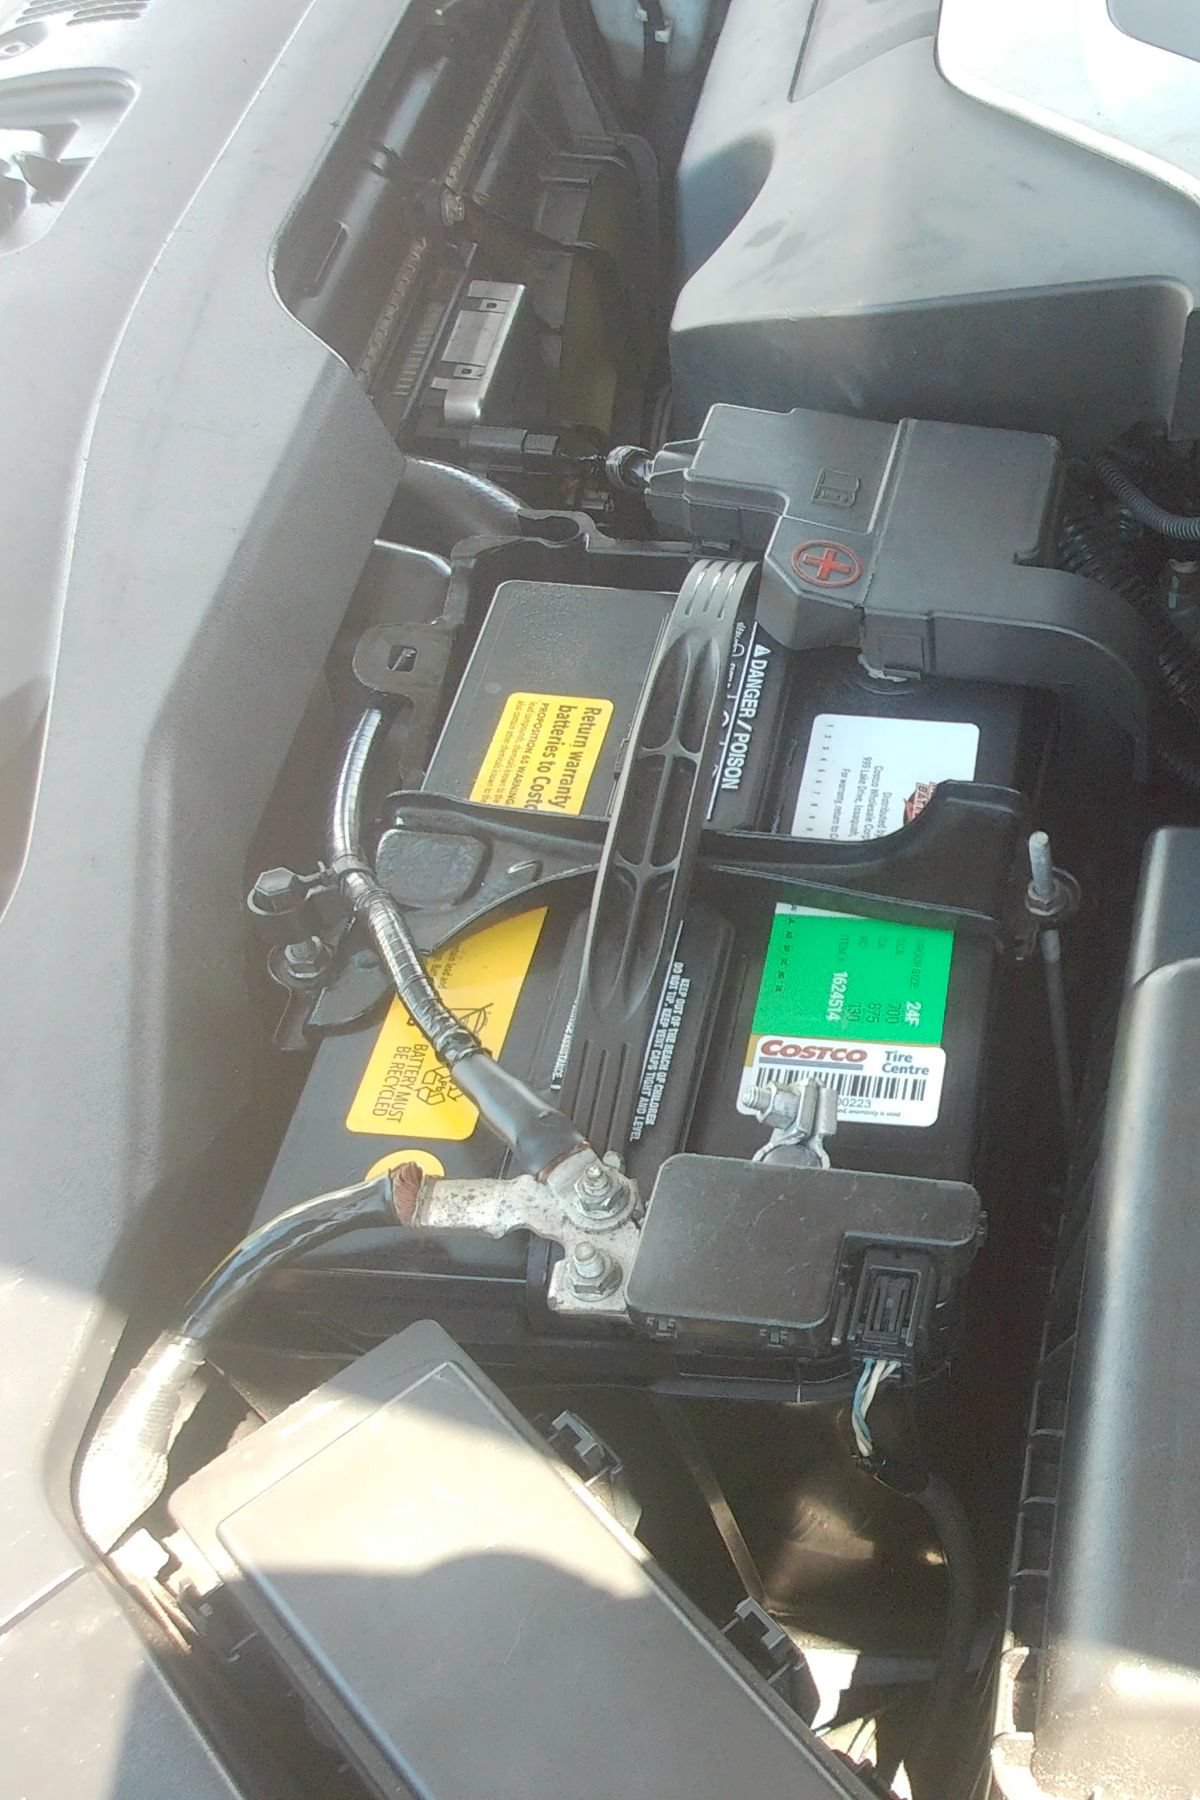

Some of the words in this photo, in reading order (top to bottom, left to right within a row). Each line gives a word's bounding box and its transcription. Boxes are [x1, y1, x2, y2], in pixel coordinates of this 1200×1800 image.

[526, 703, 549, 755] PROPOSITION
[545, 705, 577, 758] batteries
[573, 707, 602, 748] Return
[521, 755, 530, 764] 65
[537, 757, 557, 773] to
[861, 756, 873, 768] 999
[548, 751, 583, 808] warranty
[859, 769, 870, 784] Lake
[524, 776, 551, 810] Costc
[674, 962, 684, 972] DO
[669, 974, 680, 991] NOT
[679, 978, 690, 997] KEEP
[674, 998, 685, 1014] OUT
[826, 971, 848, 1022] 1624514
[659, 1008, 672, 1029] KEEP
[670, 1015, 681, 1027] OF
[847, 1002, 862, 1023] 130
[866, 1002, 881, 1023] 875
[887, 1002, 901, 1024] 700
[904, 1001, 922, 1028] 24F
[654, 1029, 667, 1049] VENT
[393, 1046, 411, 1059] BE
[648, 1050, 661, 1070] CAPS
[658, 1044, 674, 1071] REACH
[885, 1051, 912, 1063] Tire
[404, 1043, 428, 1090] BATTERY
[882, 1063, 929, 1075] Centre
[642, 1071, 654, 1097] TIGHT
[656, 1072, 667, 1083] OF
[373, 1061, 405, 1116] RECYCLED
[387, 1091, 411, 1123] MUST
[637, 1097, 648, 1114] AND
